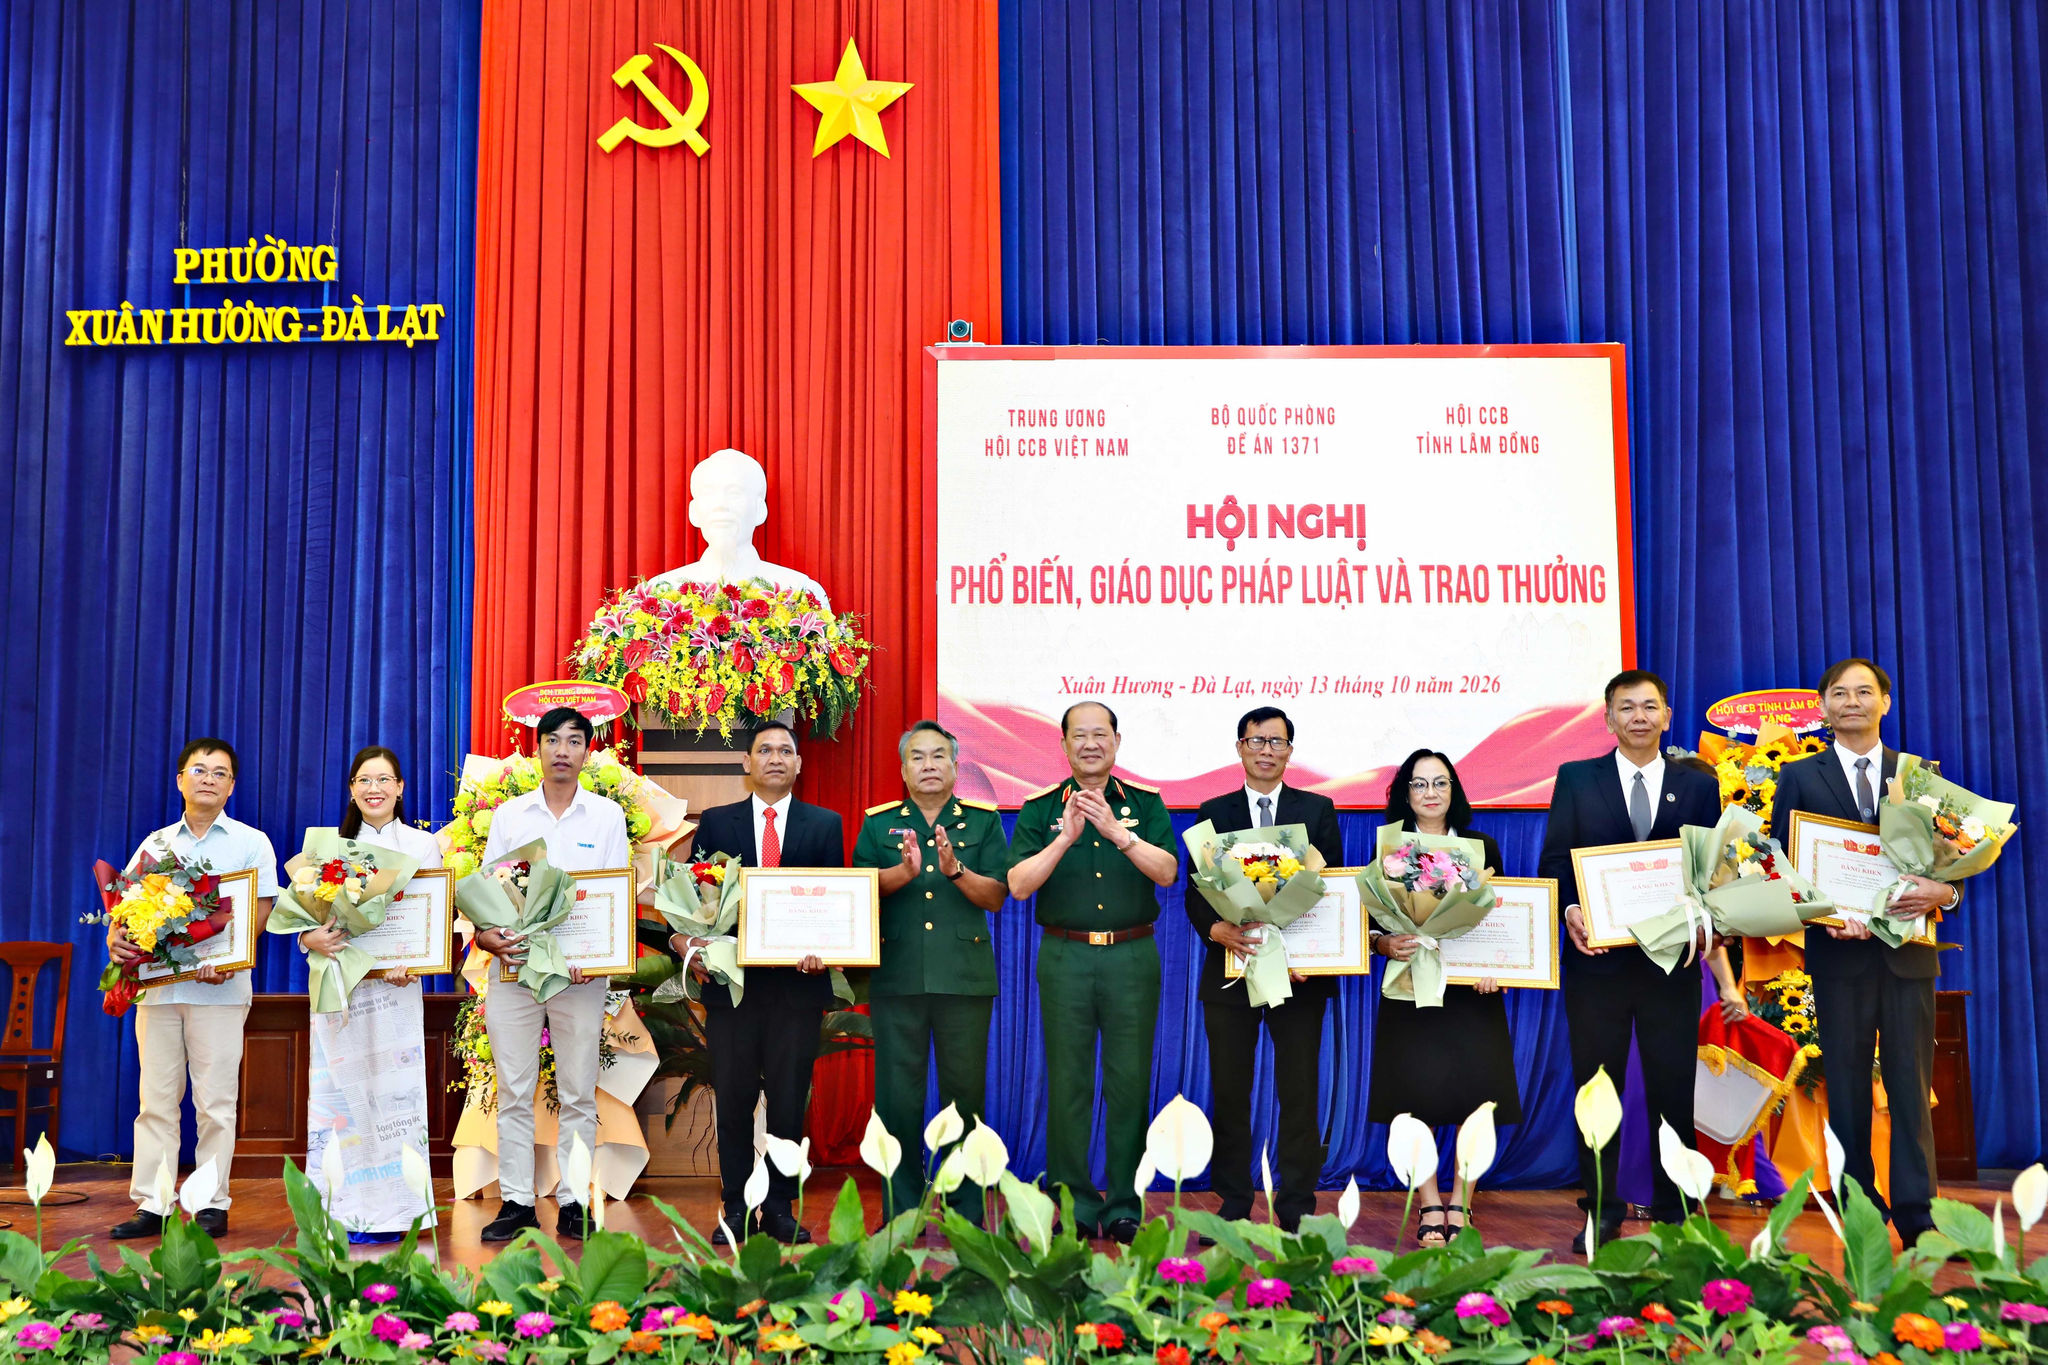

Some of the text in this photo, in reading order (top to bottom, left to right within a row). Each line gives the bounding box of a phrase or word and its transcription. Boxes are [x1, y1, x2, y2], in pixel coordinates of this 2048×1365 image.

[174, 234, 338, 284] PHƯỜNG
[64, 301, 165, 346] XUÂN
[169, 298, 303, 344] HƯƠNG
[322, 294, 371, 342] ĐÀ
[376, 303, 445, 348] LẠT
[1008, 408, 1106, 428] TRUNG ƯƠNG
[1211, 403, 1336, 428] BỘ QUỐC PHÒNG
[1446, 403, 1508, 428] HỘI CCB
[985, 435, 1129, 459] HỘI CCB VIỆT NAM
[1227, 432, 1319, 455] ĐỀ ÁN 1371
[1416, 431, 1540, 455] TỈNH LÂM ĐỒNG
[1187, 495, 1367, 552] HỘI NGHỊ
[951, 552, 1606, 611] PHỔ BIẾN, GIÁO DỤC PHÁP LUẬT VÀ TRAO THƯỞNG
[1058, 675, 1106, 695] Xuân
[1112, 676, 1174, 698] Hương
[1191, 676, 1217, 694] Đà
[1222, 676, 1255, 699] Lạt,
[1261, 676, 1303, 699] ngày
[1310, 676, 1329, 694] 13
[1335, 675, 1384, 698] tháng
[1391, 676, 1410, 694] 10
[1416, 677, 1453, 694] năm
[1459, 675, 1501, 694] 2026
[539, 695, 551, 704] HỘI
[566, 695, 580, 704] VIỆT
[1716, 703, 1734, 716] HỘI
[1736, 703, 1756, 714] CCB
[1784, 698, 1805, 711] LÂM
